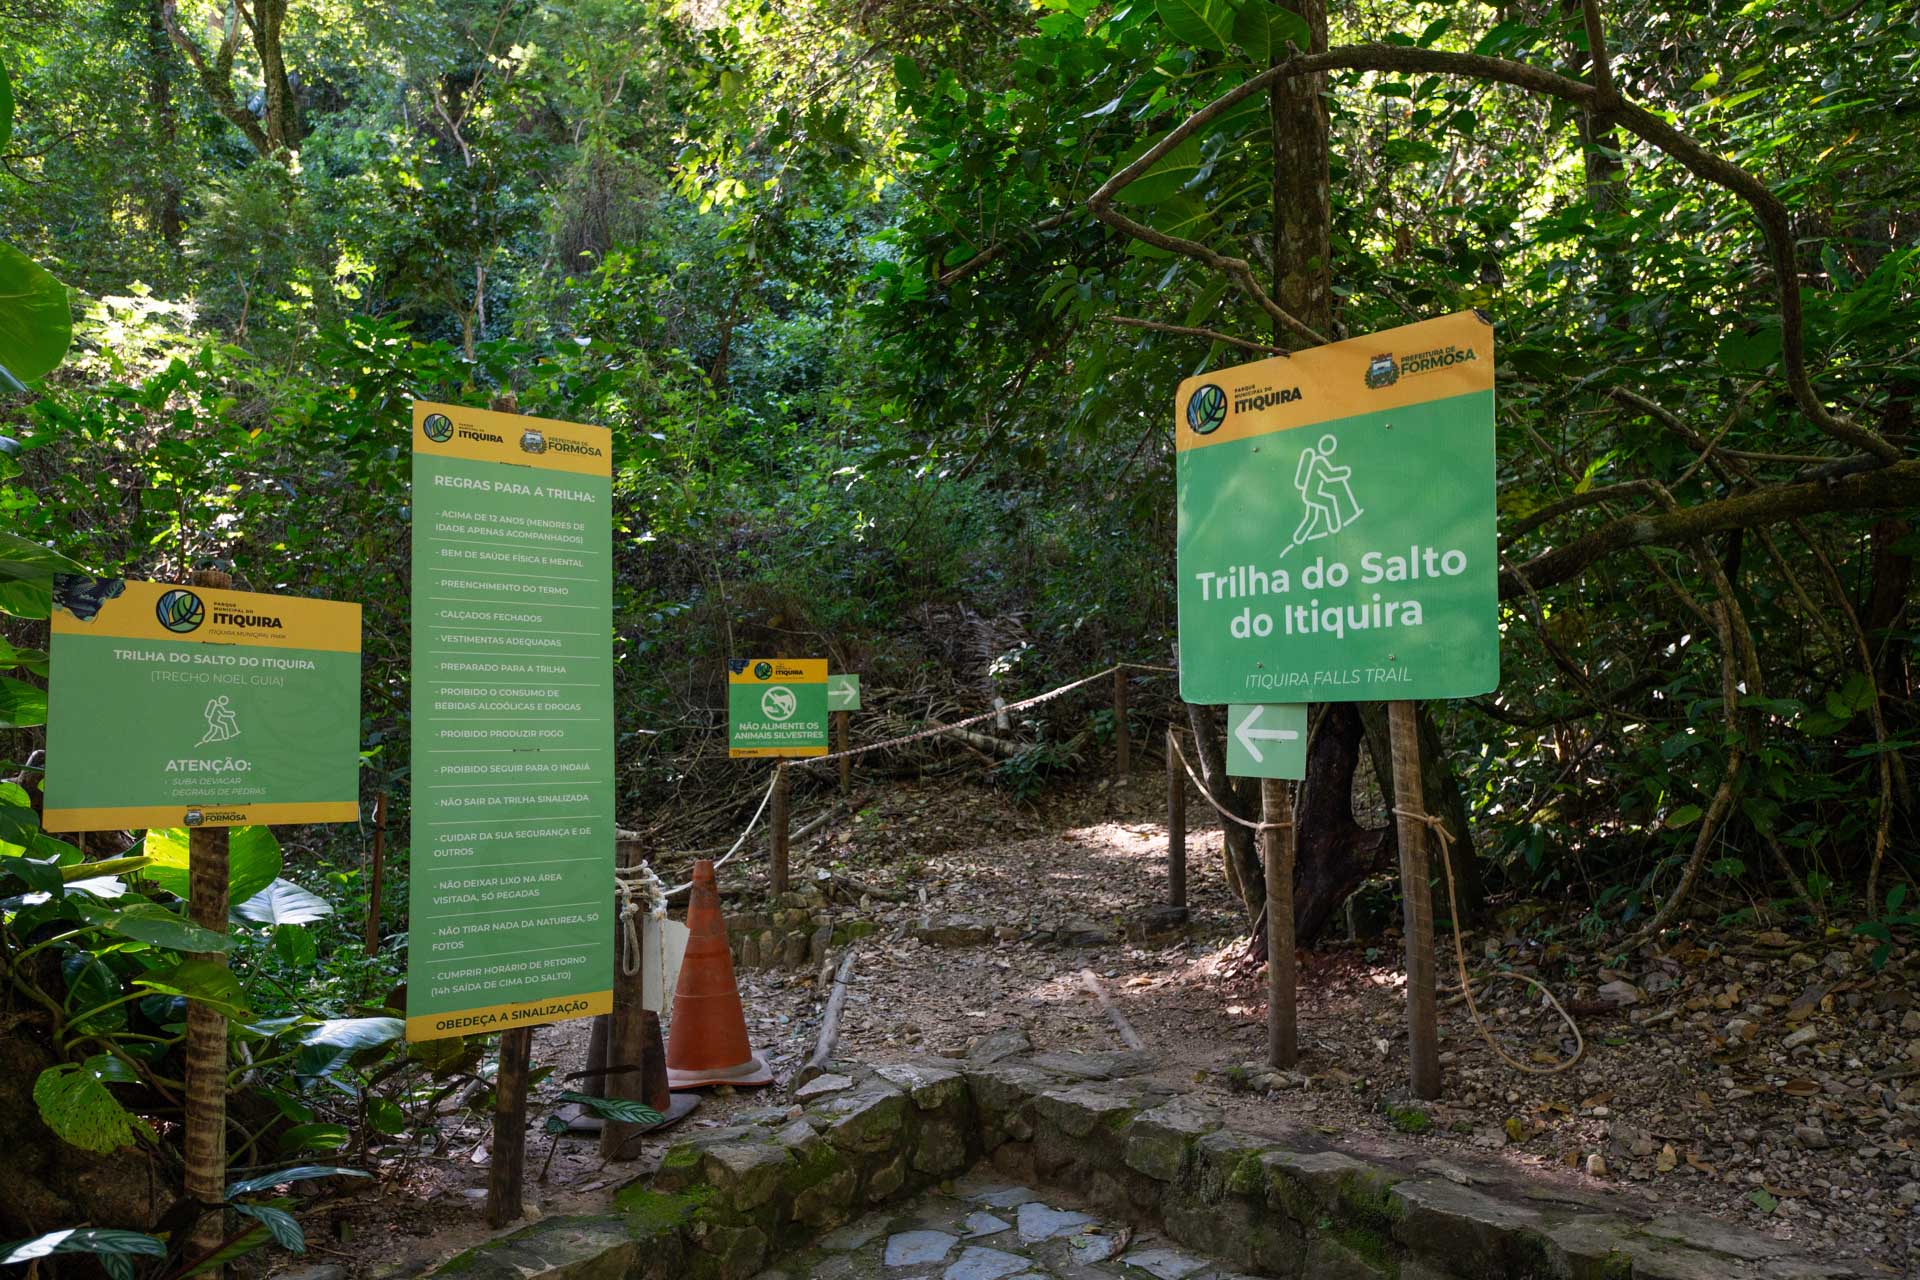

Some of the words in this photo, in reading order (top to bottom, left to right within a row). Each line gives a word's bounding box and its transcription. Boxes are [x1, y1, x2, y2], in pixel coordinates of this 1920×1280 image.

[1401, 348, 1476, 375] FORMOSA
[1234, 387, 1302, 414] ITIQUIRA
[458, 430, 503, 443] ITIQUIRA
[548, 442, 602, 456] FORMOSA
[435, 475, 490, 491] REGRAS
[495, 482, 531, 496] PARA
[535, 488, 543, 497] A
[546, 488, 595, 503] TRILHA:
[442, 511, 472, 520] ACIMA
[500, 516, 524, 525] ANOS
[527, 519, 571, 530] (MENORES
[573, 522, 584, 530] DE
[436, 524, 465, 532] IDADE
[468, 527, 504, 537] APENAS
[506, 530, 583, 544] ACOMPANHADOS)
[442, 549, 462, 558] BEM
[480, 551, 510, 561] SAÚDE
[513, 554, 539, 564] FÍSICA
[549, 558, 583, 567] MENTAL
[1195, 564, 1290, 601] Trilha
[1302, 558, 1349, 590] do
[1361, 545, 1467, 585] Salto
[441, 580, 521, 592] PREENCHIMENTO
[538, 586, 568, 595] TERMO
[214, 613, 282, 628] ITIQUIRA
[441, 610, 490, 620] CALÇADOS
[493, 613, 542, 622] FECHADOS
[1230, 607, 1273, 639] do
[1285, 595, 1423, 639] Itiquira
[441, 636, 504, 644] VESTIMENTAS
[506, 638, 561, 647] ADEQUADAS
[113, 649, 166, 663] TRILHA
[169, 652, 191, 663] DO
[193, 655, 236, 666] SALTO
[240, 657, 259, 667] DO
[262, 658, 315, 670] ITIQUIRA
[441, 663, 498, 671] PREPARADO
[151, 671, 210, 683] (TRECHO
[213, 673, 247, 685] NOEL
[251, 675, 284, 687] GUIA)
[1245, 671, 1309, 690] ITIQUIRA
[1314, 669, 1360, 686] FALLS
[1365, 667, 1412, 683] TRAIL
[478, 702, 535, 710] ALCOÓLICAS
[165, 757, 252, 774] ATENÇÃO:
[560, 762, 590, 771] INDAIÁ
[441, 798, 462, 807] NÃO
[464, 798, 485, 806] SAIR
[538, 794, 589, 803] SINALIZADA
[440, 833, 477, 842] CUIDAR
[495, 831, 513, 840] SUA
[516, 828, 569, 839] SEGURANÇA
[434, 848, 474, 857] OUTROS
[440, 880, 461, 890] NÃO
[464, 879, 498, 888] DEIXAR
[500, 878, 520, 886] LIXO
[538, 873, 562, 884] ÁREA
[433, 895, 479, 905] VISITADA,
[482, 892, 494, 900] SÓ
[497, 890, 540, 899] PEGADAS
[439, 926, 460, 936] NÃO
[462, 925, 490, 934] TIRAR
[493, 922, 519, 932] NADA
[522, 921, 534, 929] DA
[587, 913, 599, 922] SÓ
[432, 942, 464, 951] FOTOS
[437, 968, 481, 981] CUMPRIR
[484, 962, 527, 975] HORÁRIO
[530, 961, 541, 969] DE
[544, 956, 586, 968] RETORNO
[432, 987, 450, 997] (14h
[452, 983, 481, 994] SAÍDA
[484, 981, 497, 990] DE
[499, 978, 523, 988] CIMA
[526, 976, 538, 985] DO
[541, 972, 571, 984] SALTO)
[436, 1014, 496, 1030] OBEDEÇA
[500, 1013, 508, 1021] A
[512, 1001, 589, 1020] SINALIZAÇÃO
